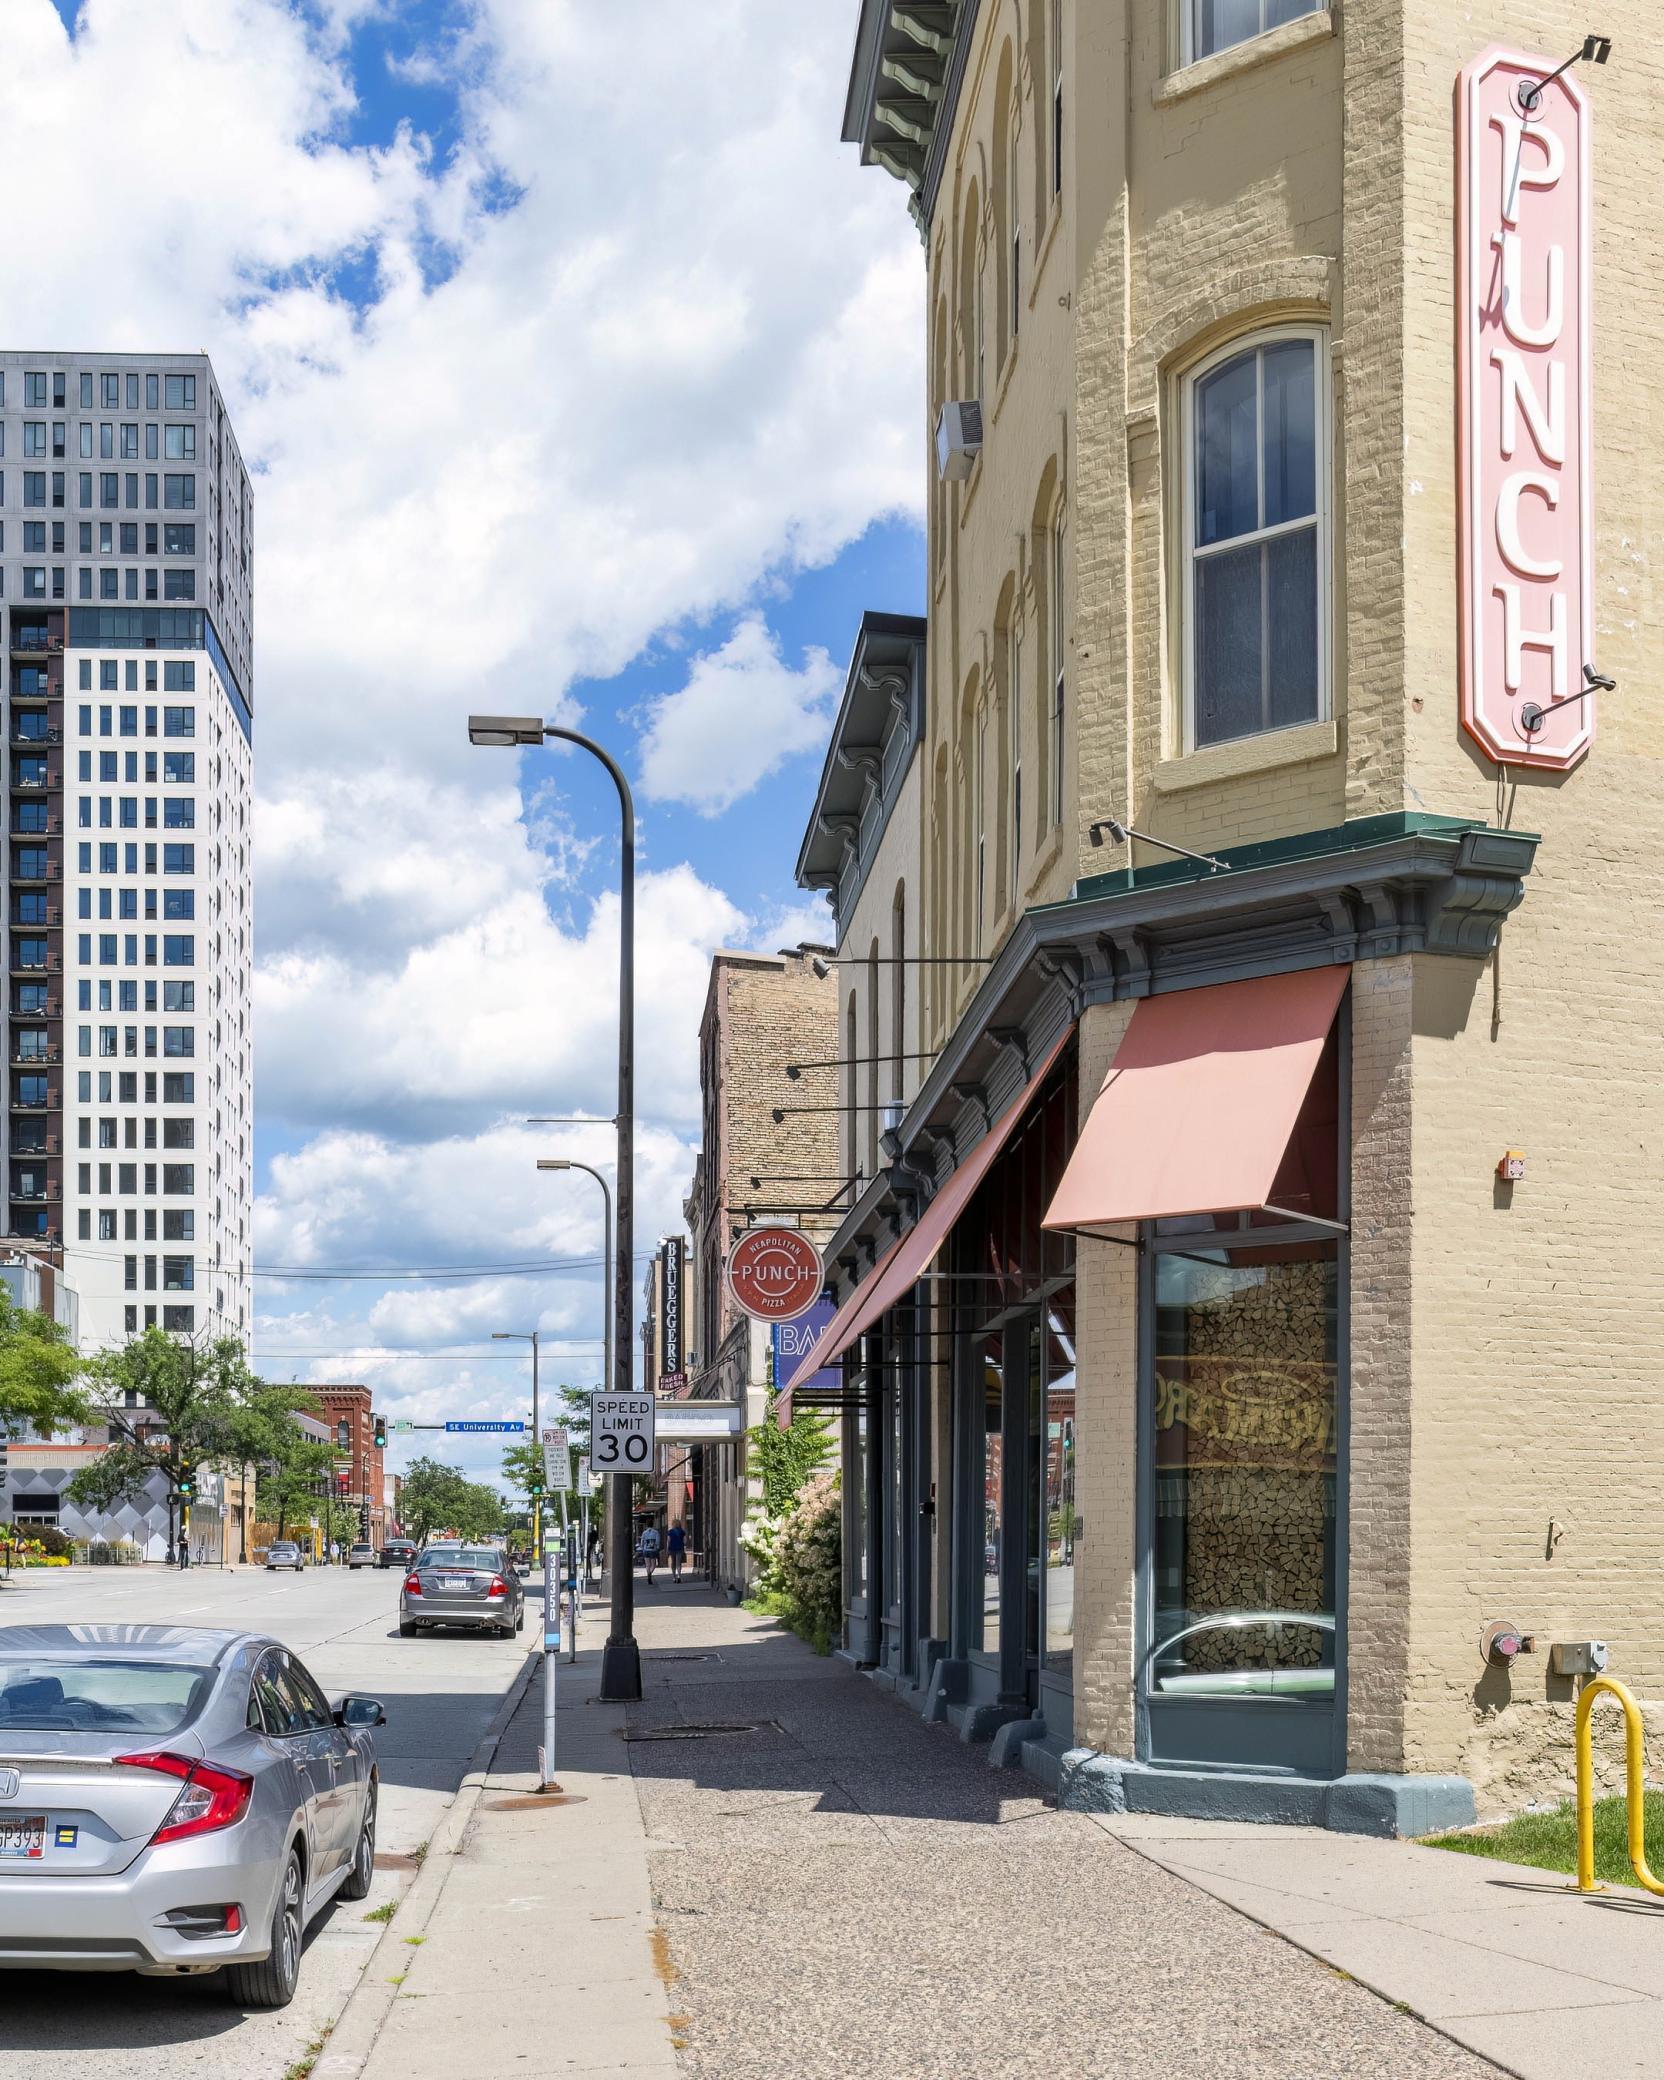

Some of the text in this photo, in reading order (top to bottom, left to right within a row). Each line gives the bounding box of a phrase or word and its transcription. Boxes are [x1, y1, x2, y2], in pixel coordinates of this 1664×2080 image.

[1488, 112, 1567, 699] PUNCH
[749, 1238, 801, 1255] NEAPOLITAN
[742, 1265, 808, 1281] PUNCH
[666, 1242, 677, 1373] BRUEGGERS
[761, 1298, 786, 1308] PIZZA
[597, 1401, 650, 1414] SPEED
[450, 1422, 521, 1433] SE University Av
[602, 1418, 644, 1430] LIMIT
[597, 1434, 648, 1463] 30
[549, 1554, 557, 1622] 30350
